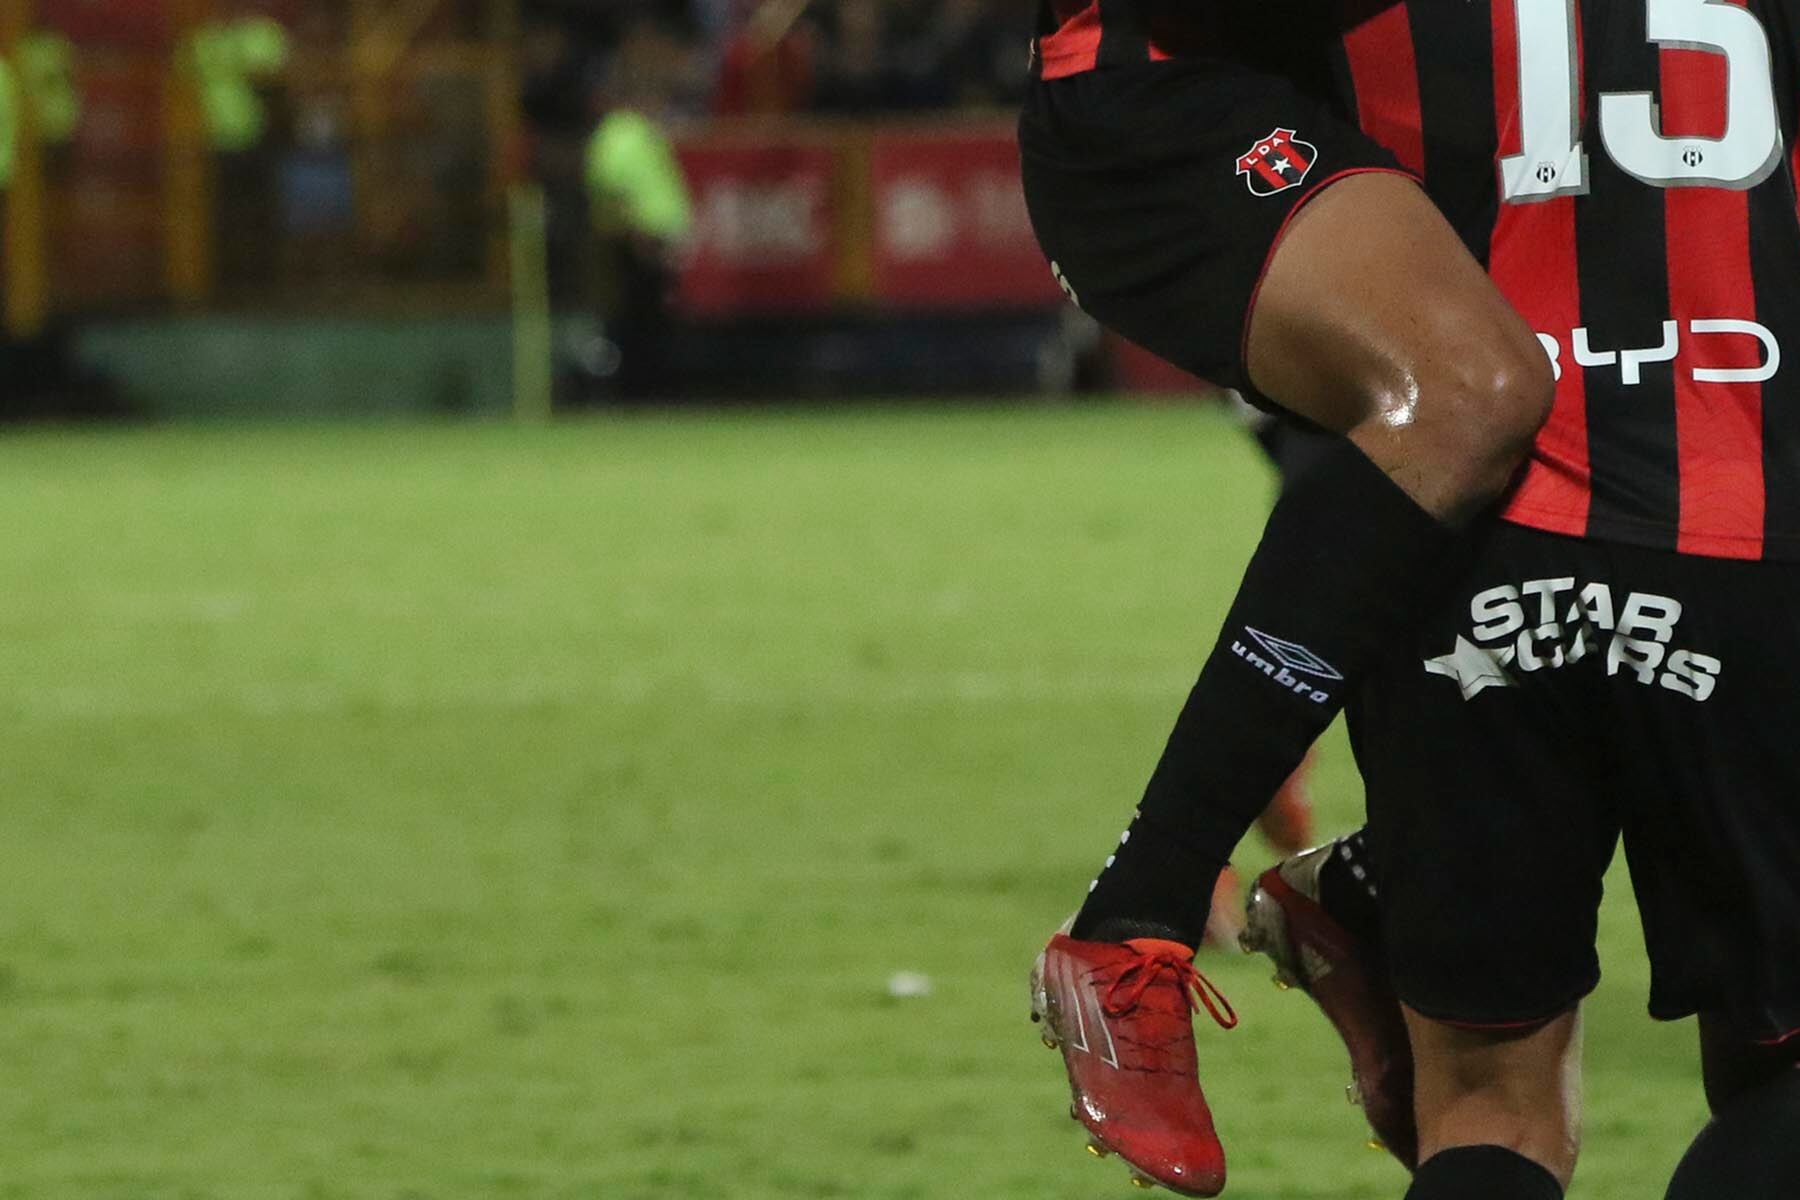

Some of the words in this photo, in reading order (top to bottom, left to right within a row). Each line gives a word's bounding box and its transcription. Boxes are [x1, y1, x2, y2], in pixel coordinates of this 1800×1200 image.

[1246, 137, 1285, 166] LDA
[1471, 577, 1682, 643] STAR
[1231, 641, 1329, 703] umbro
